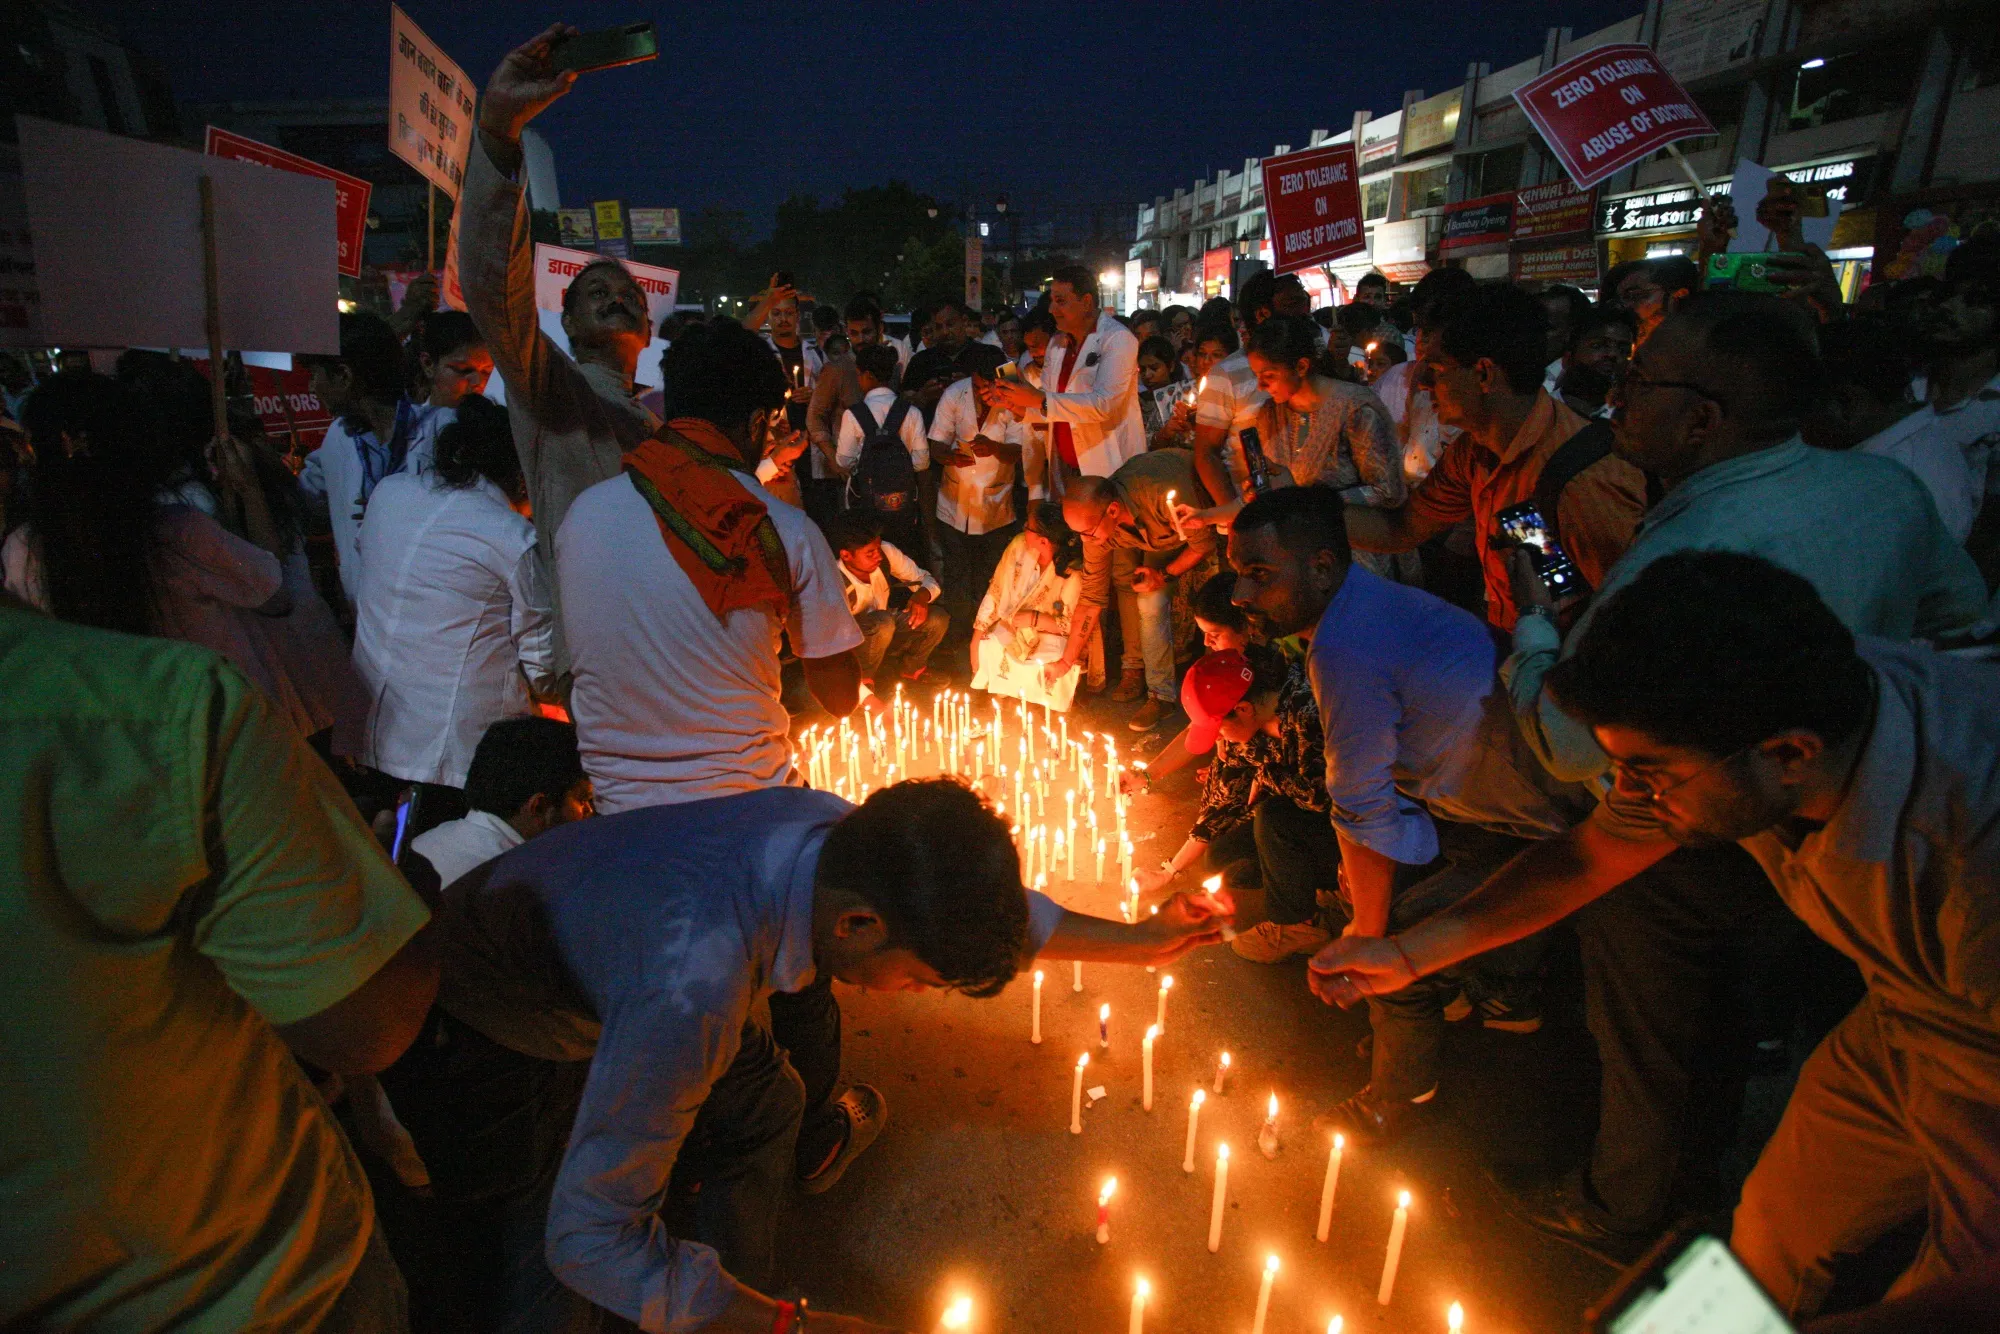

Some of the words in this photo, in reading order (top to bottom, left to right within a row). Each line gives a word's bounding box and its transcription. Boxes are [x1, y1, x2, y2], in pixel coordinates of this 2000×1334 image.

[1551, 76, 1595, 109] ZERO
[1590, 58, 1658, 86] TOLERANCE
[1620, 84, 1646, 105] ON
[1580, 121, 1635, 162] ABUSE
[1630, 111, 1654, 133] OF
[1651, 103, 1698, 126] DOCTORS
[1280, 171, 1304, 196] ZERO
[1305, 162, 1348, 189] TOLERANCE
[1624, 195, 1655, 210] SCHOOL
[1813, 161, 1855, 181] ITEMS
[1315, 196, 1328, 216] ON
[1284, 229, 1313, 254] ABUSE
[1313, 225, 1325, 245] OF
[1326, 216, 1358, 242] DOCTORS
[1451, 217, 1480, 231] Bombay
[1480, 214, 1508, 229] Dyeing
[1522, 251, 1569, 263] SANWAL
[253, 393, 321, 416] DOCORS
